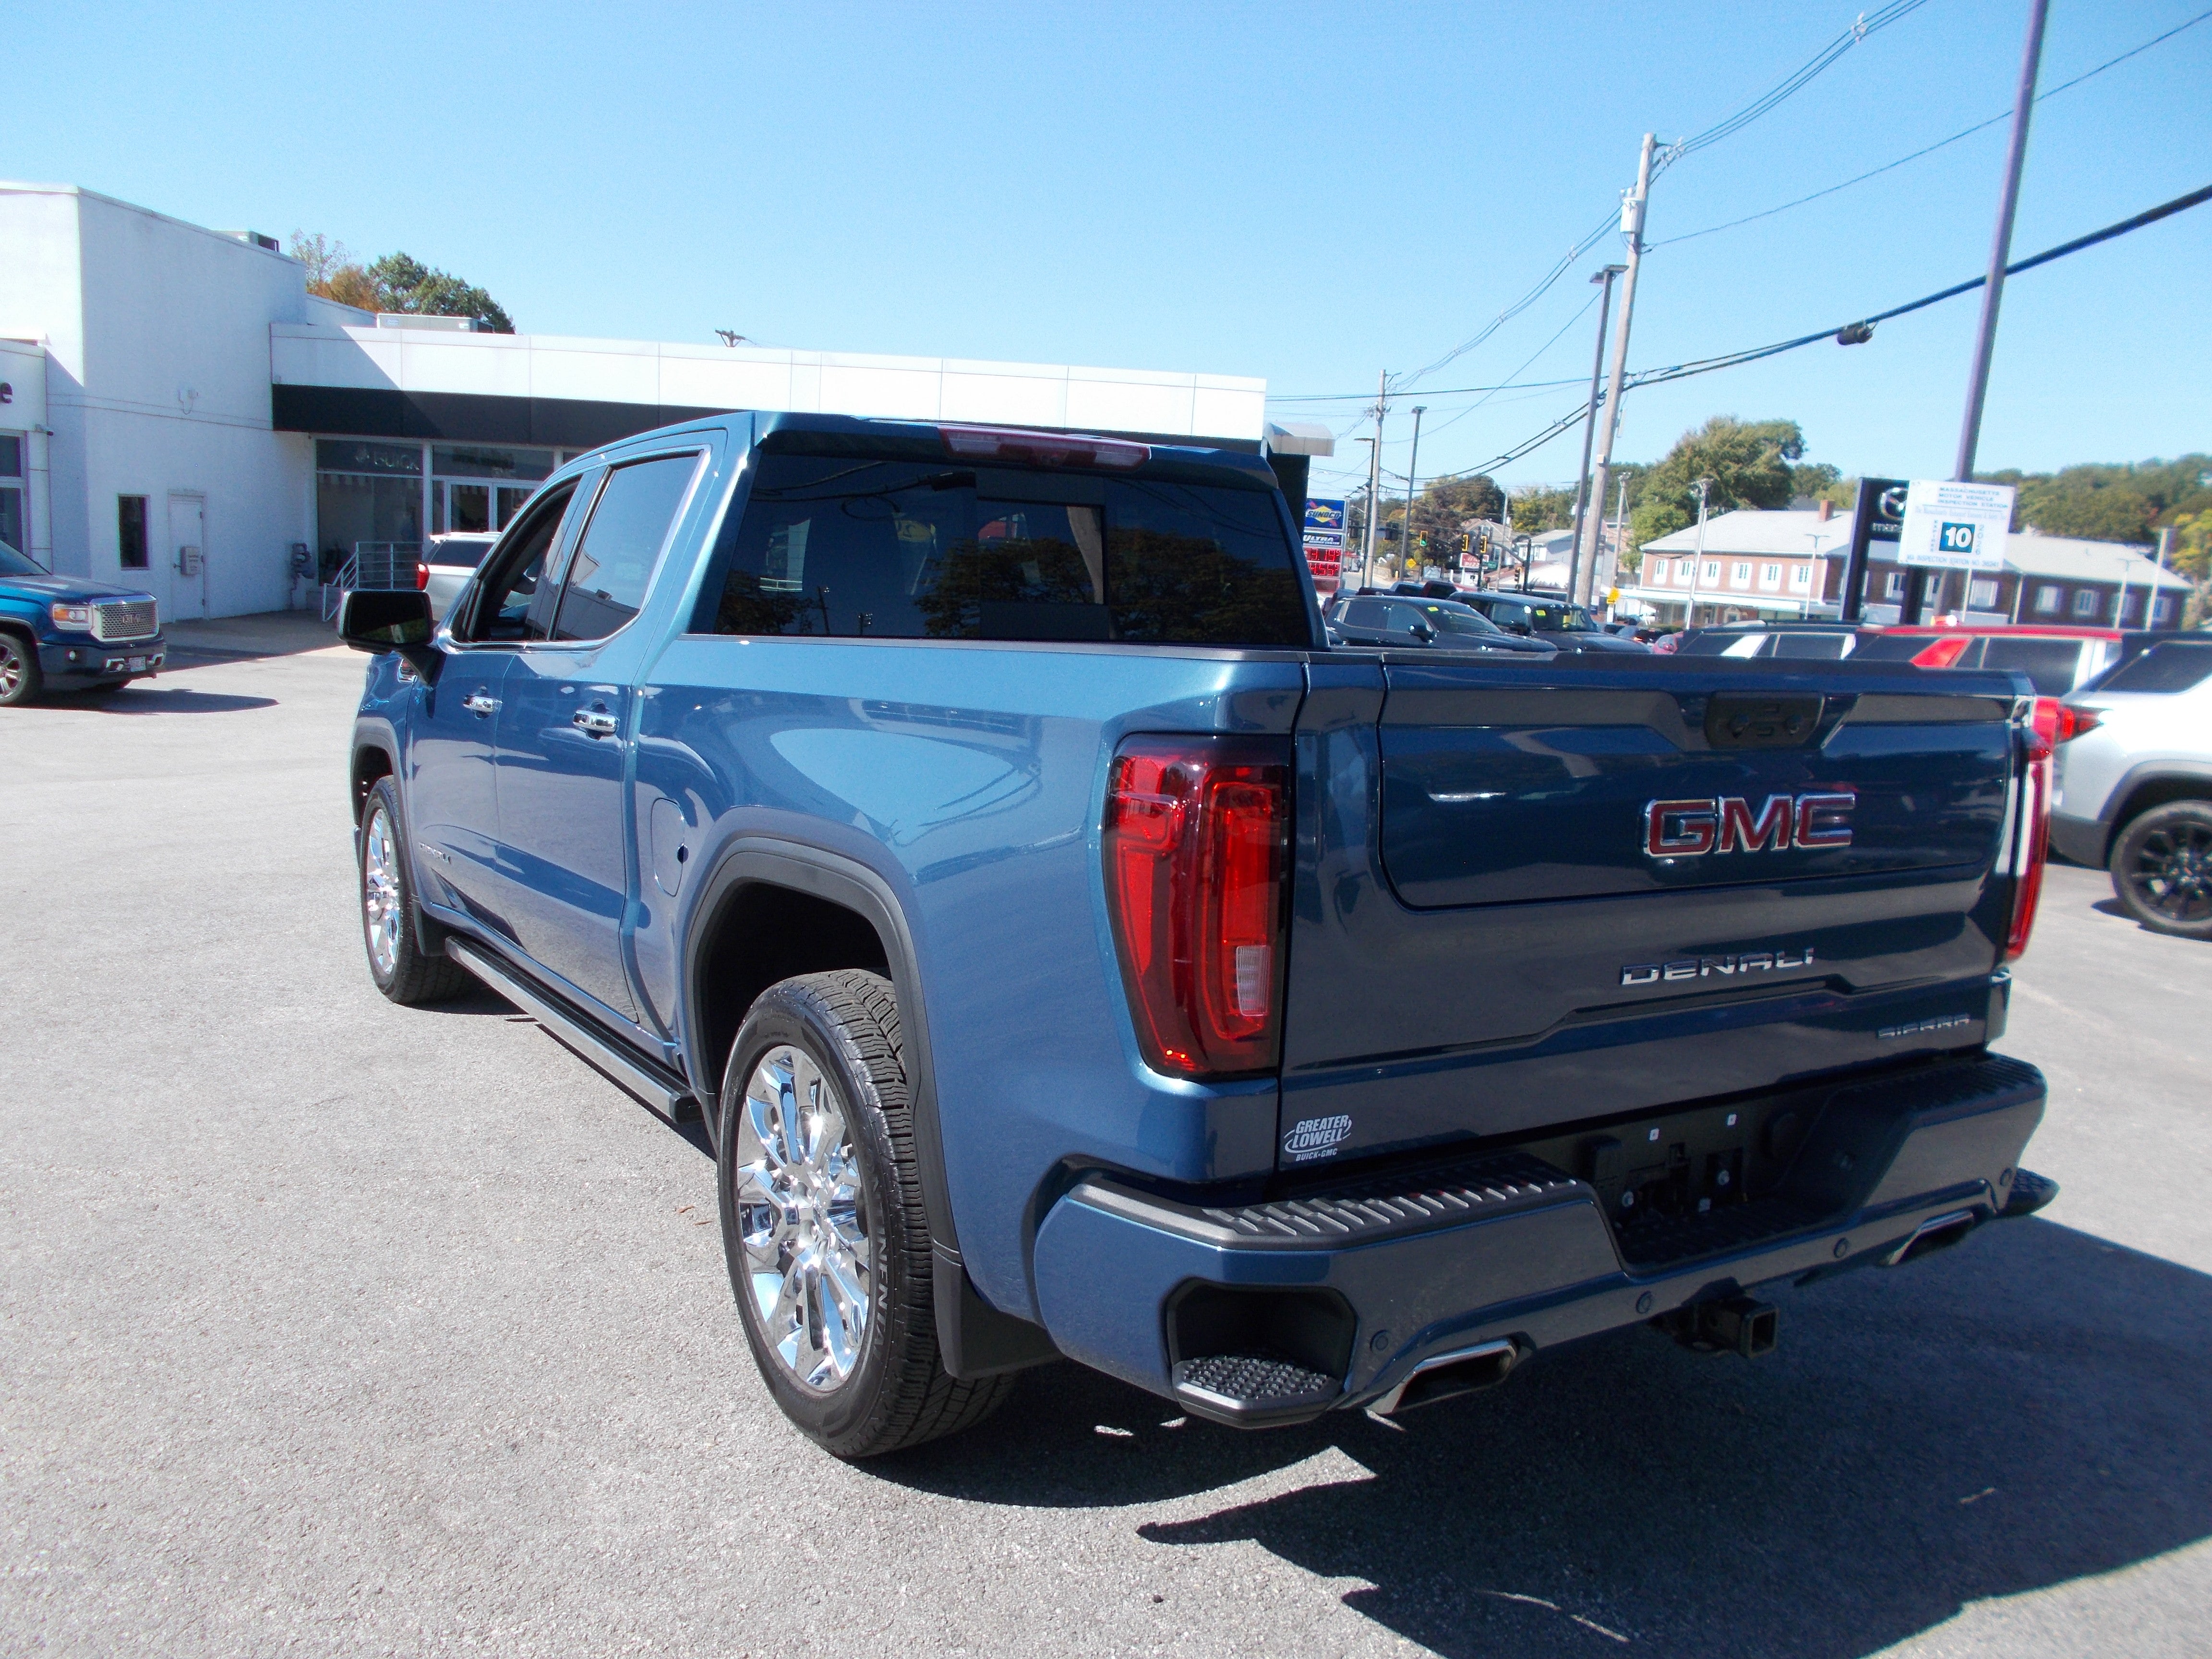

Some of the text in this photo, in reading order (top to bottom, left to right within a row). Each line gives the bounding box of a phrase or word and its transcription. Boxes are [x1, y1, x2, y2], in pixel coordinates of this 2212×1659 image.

[1307, 510, 1340, 519] SUNOCO
[1946, 526, 1972, 548] 10
[1643, 792, 1856, 857] GMC
[1621, 947, 1815, 986] DENALI
[1877, 1012, 1970, 1038] SIERRA
[1296, 1114, 1349, 1134] GREATER
[1292, 1128, 1343, 1149] LOWELL
